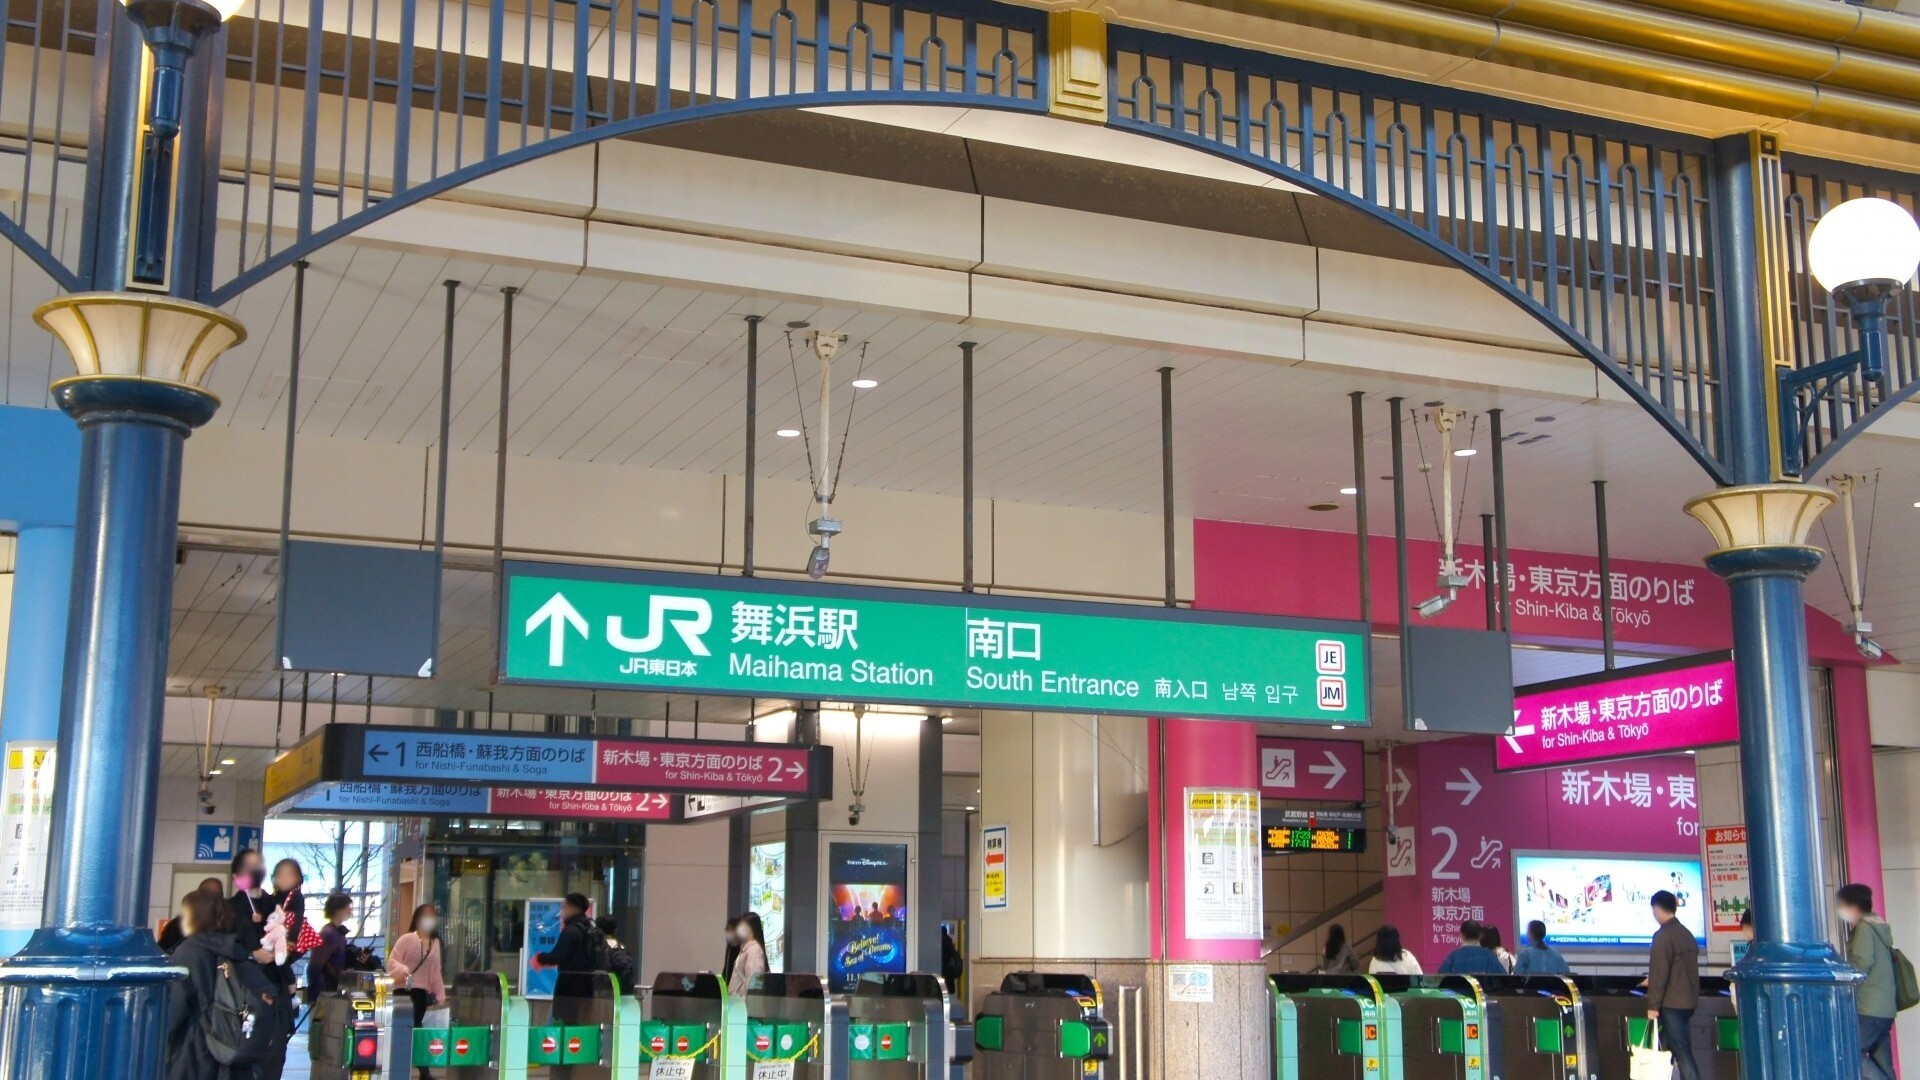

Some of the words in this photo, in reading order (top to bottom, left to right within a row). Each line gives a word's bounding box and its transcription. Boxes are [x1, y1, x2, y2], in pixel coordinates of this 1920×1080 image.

[1515, 598, 1588, 620] Shin-Kiba
[1592, 605, 1603, 621] &
[606, 594, 713, 657] JR
[730, 600, 859, 651] 舞浜駅
[967, 617, 1042, 661] 南口
[619, 657, 698, 677] JR東日本
[1323, 650, 1337, 664] JE
[729, 652, 843, 682] Maihama
[850, 661, 934, 687] Station
[966, 666, 1033, 692] South
[1041, 670, 1139, 698] Entrance
[1154, 677, 1208, 700] 南入口
[1222, 682, 1257, 703] 남쪽
[1264, 684, 1299, 704] 입구
[1322, 686, 1341, 701] JM
[1541, 678, 1723, 731] 新木場・東京方面のりば
[1542, 735, 1555, 749] for
[1557, 727, 1605, 747] Shin-Kiba
[1607, 727, 1615, 740] &
[1618, 723, 1649, 740] Tōkyō
[396, 741, 406, 767] 1
[416, 741, 586, 764] 西船橋・蘇我方面のりば
[415, 760, 428, 770] for
[431, 761, 510, 773] Nishi-Funabashi
[512, 764, 520, 773] &
[523, 765, 548, 775] Soga
[603, 749, 763, 771] 新木場・東京方面のりば
[767, 757, 783, 782] 2
[665, 770, 676, 779] for
[680, 770, 724, 781] Shin-Kiba
[727, 772, 733, 781] &
[735, 772, 763, 784] Tōkyō
[338, 795, 350, 804] for
[549, 801, 558, 810] for
[561, 802, 599, 811] Shin-Kiba
[601, 803, 607, 811] &
[1676, 816, 1698, 836] for
[1431, 825, 1460, 880] 2
[1431, 886, 1471, 904] 新木場
[1432, 905, 1484, 922] 東京方面
[1433, 923, 1443, 933] for
[1365, 1025, 1377, 1040] IC
[1467, 1025, 1477, 1039] IC
